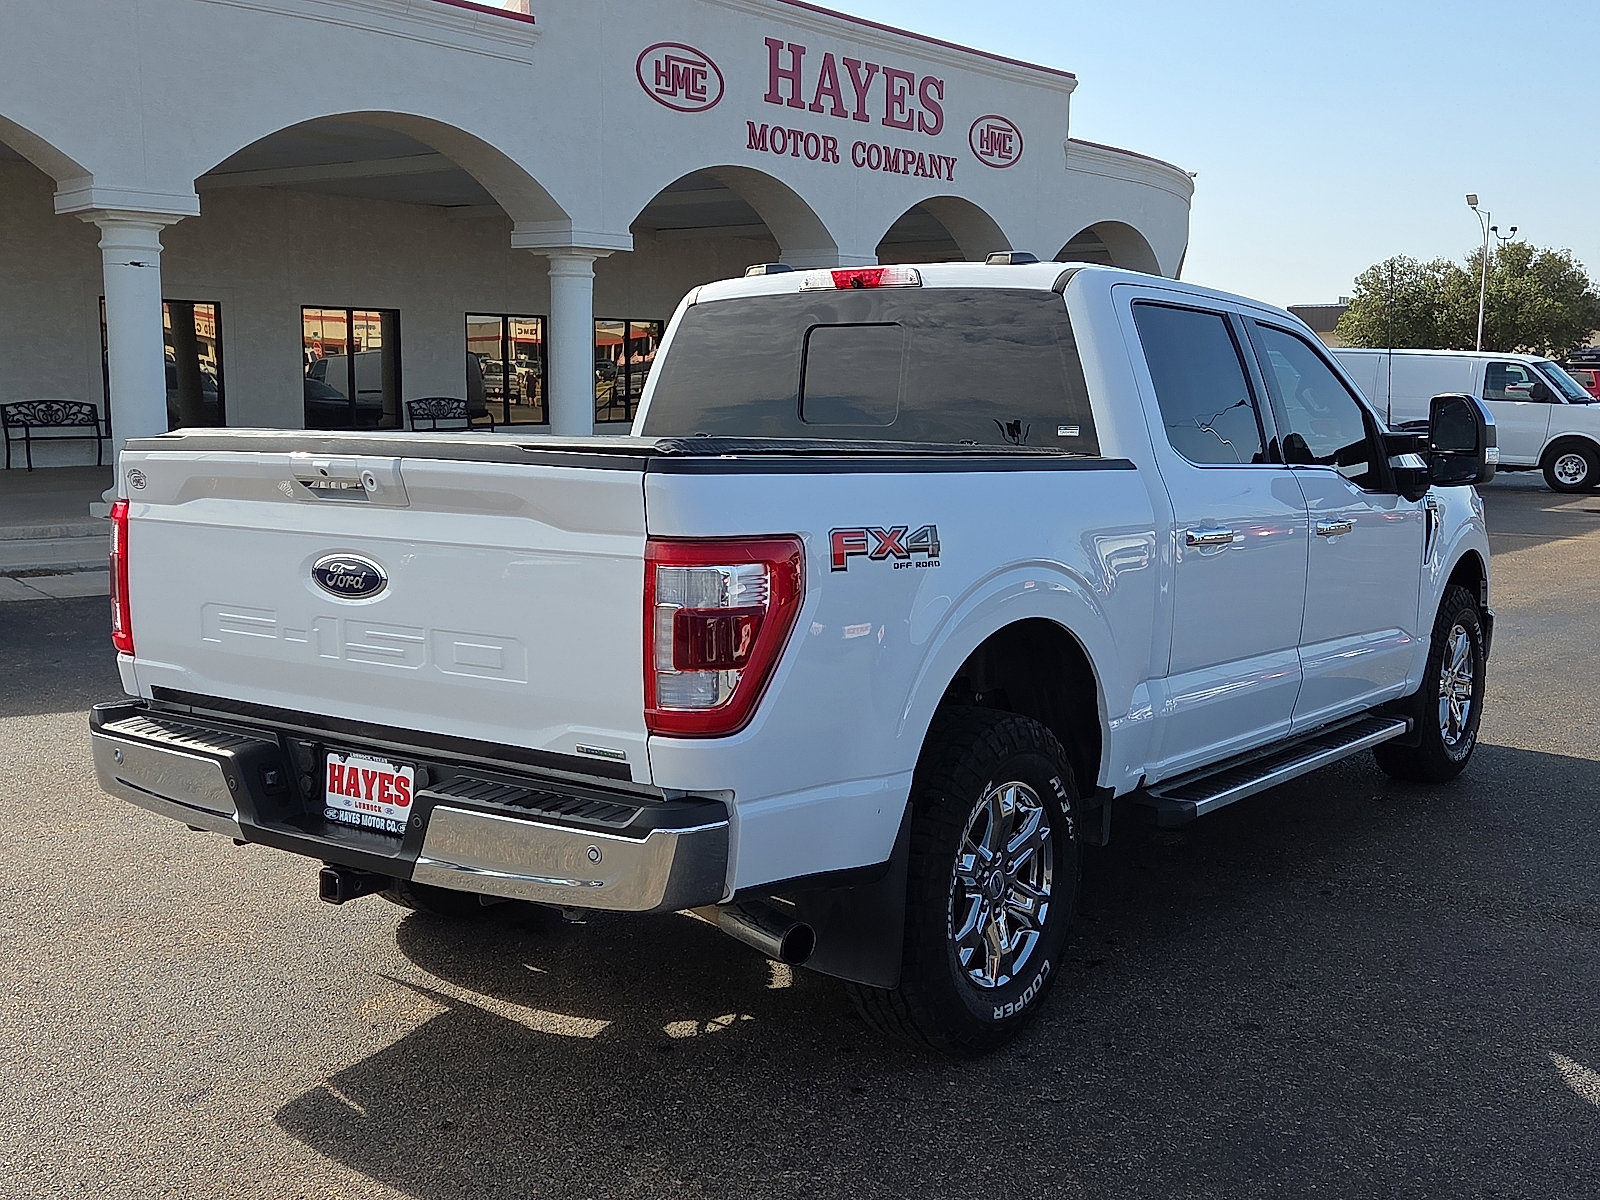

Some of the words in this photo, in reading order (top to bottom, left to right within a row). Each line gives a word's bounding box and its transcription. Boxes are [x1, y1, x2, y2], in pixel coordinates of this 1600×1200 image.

[764, 37, 945, 136] HAYES
[746, 121, 840, 164] MOTOR
[851, 141, 958, 181] COMPANY
[828, 525, 940, 573] FX4
[893, 562, 912, 570] OFF
[916, 560, 940, 570] ROAD
[325, 563, 367, 591] Ford
[201, 602, 528, 684] F-150
[1453, 730, 1475, 761] COOPER
[329, 763, 410, 807] HAYES
[339, 810, 361, 825] HAYES
[361, 814, 386, 831] MOTOR
[386, 819, 398, 833] CO.
[993, 959, 1052, 1020] COOPER
